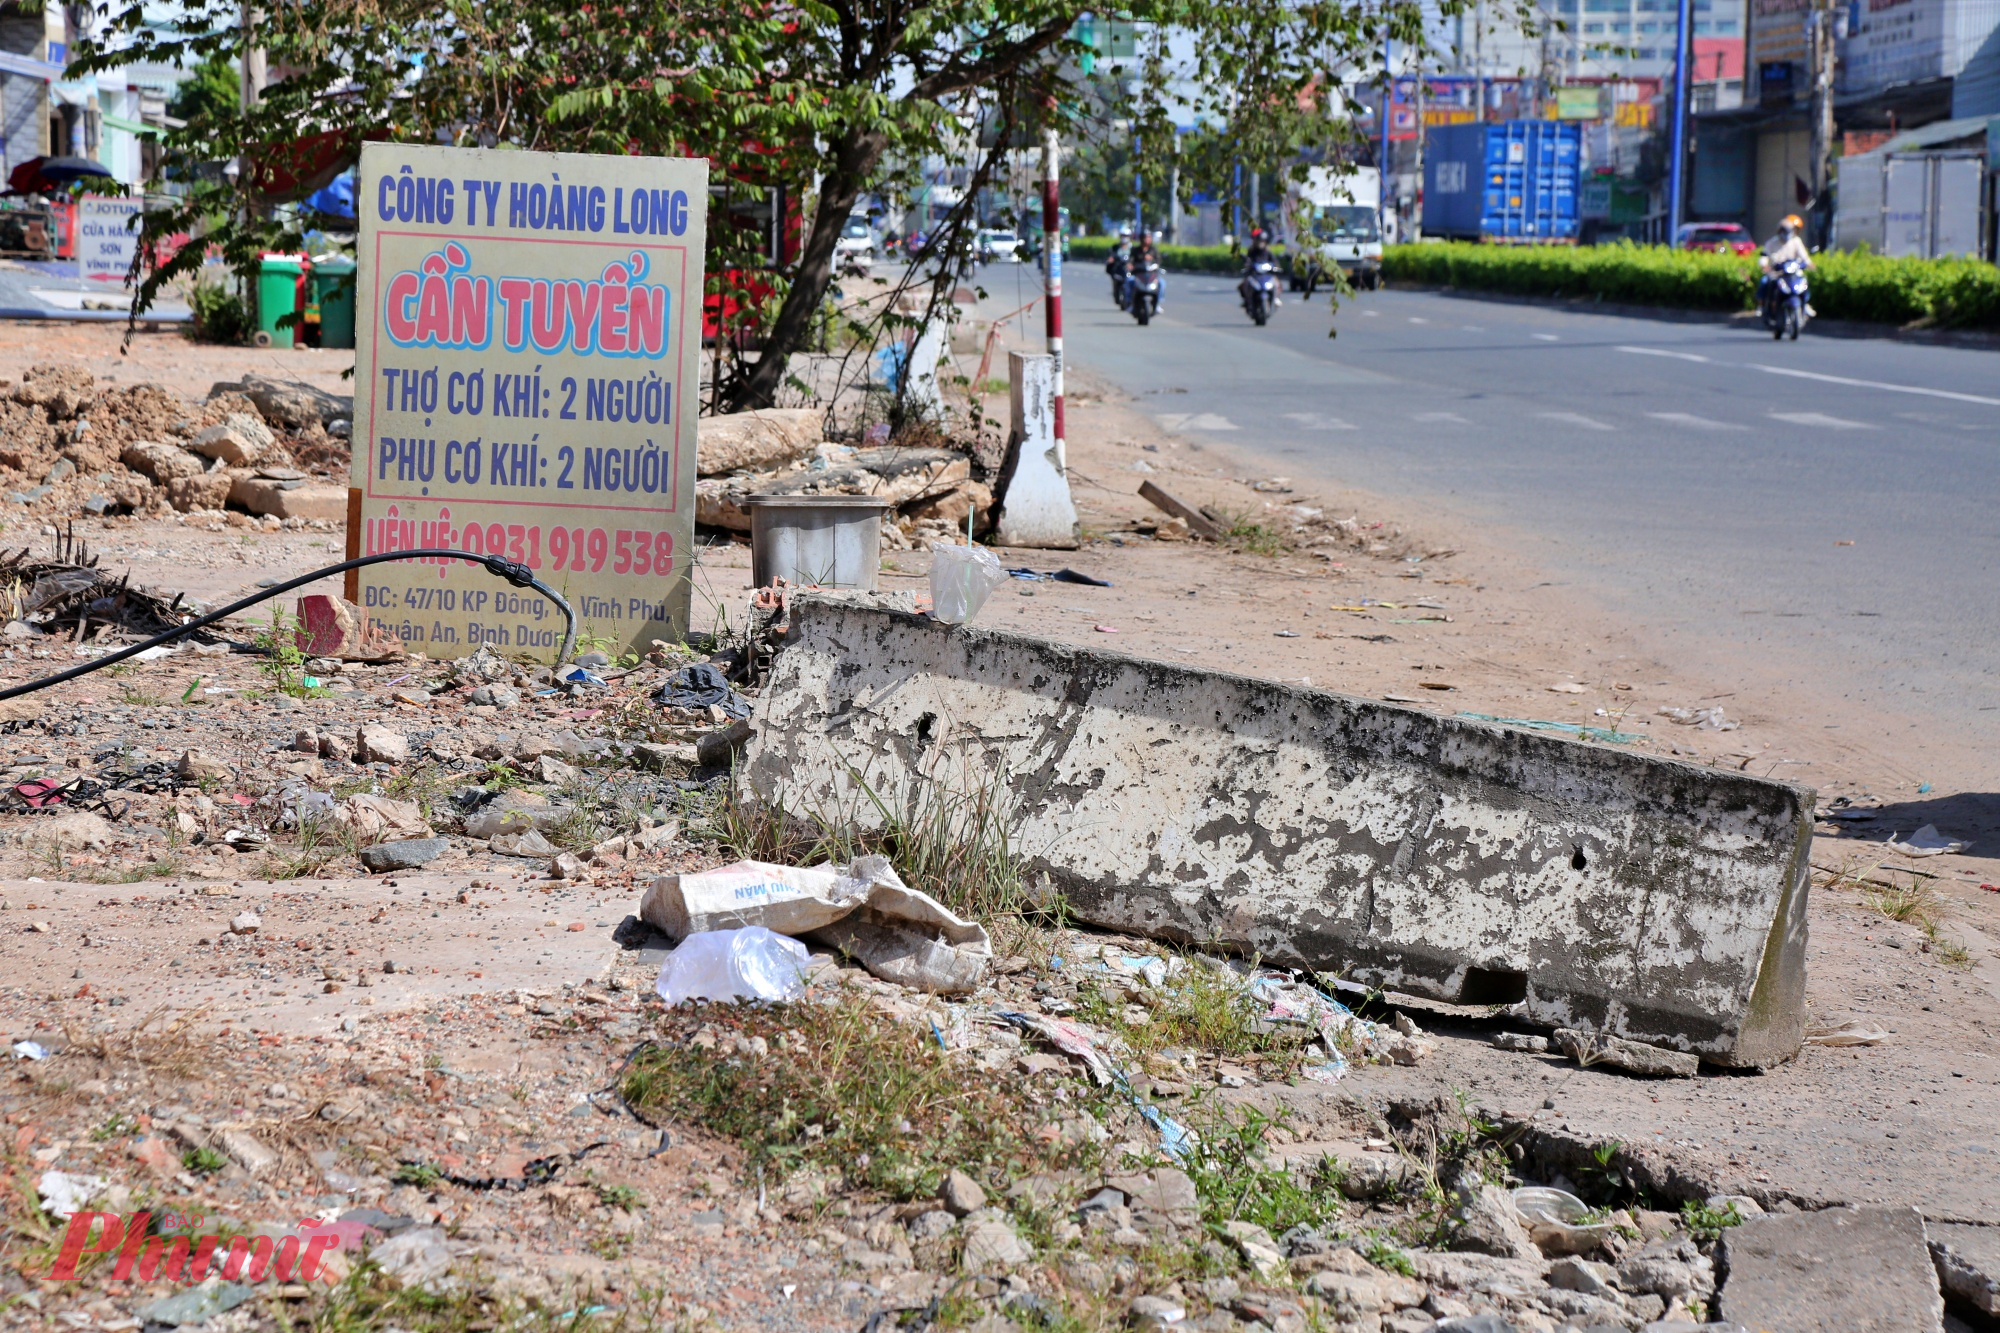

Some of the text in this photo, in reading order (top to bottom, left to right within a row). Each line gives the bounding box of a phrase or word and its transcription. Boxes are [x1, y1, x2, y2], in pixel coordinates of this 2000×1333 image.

[96, 203, 138, 215] JOTUN
[378, 165, 688, 237] CÔNG TY HOÀNG LONG
[99, 242, 122, 255] SƠN
[114, 261, 131, 270] PH
[385, 240, 671, 360] CẦN TUYỂN
[382, 364, 672, 428] THỢ CƠ KHÍ: 2 NGƯỜI
[378, 433, 670, 497] PHỤ CƠ KHÍ: 2 NGƯỜI
[365, 504, 416, 564] LIÊN
[548, 525, 609, 573] 919
[613, 529, 674, 577] 538
[364, 585, 398, 608] ĐC:
[403, 587, 456, 611] 47/10
[462, 590, 488, 612] KP
[494, 592, 549, 621] Đông,
[580, 595, 622, 619] Vĩnh
[628, 599, 671, 624] Phú,
[430, 620, 461, 645] An,
[467, 622, 510, 646] Bình
